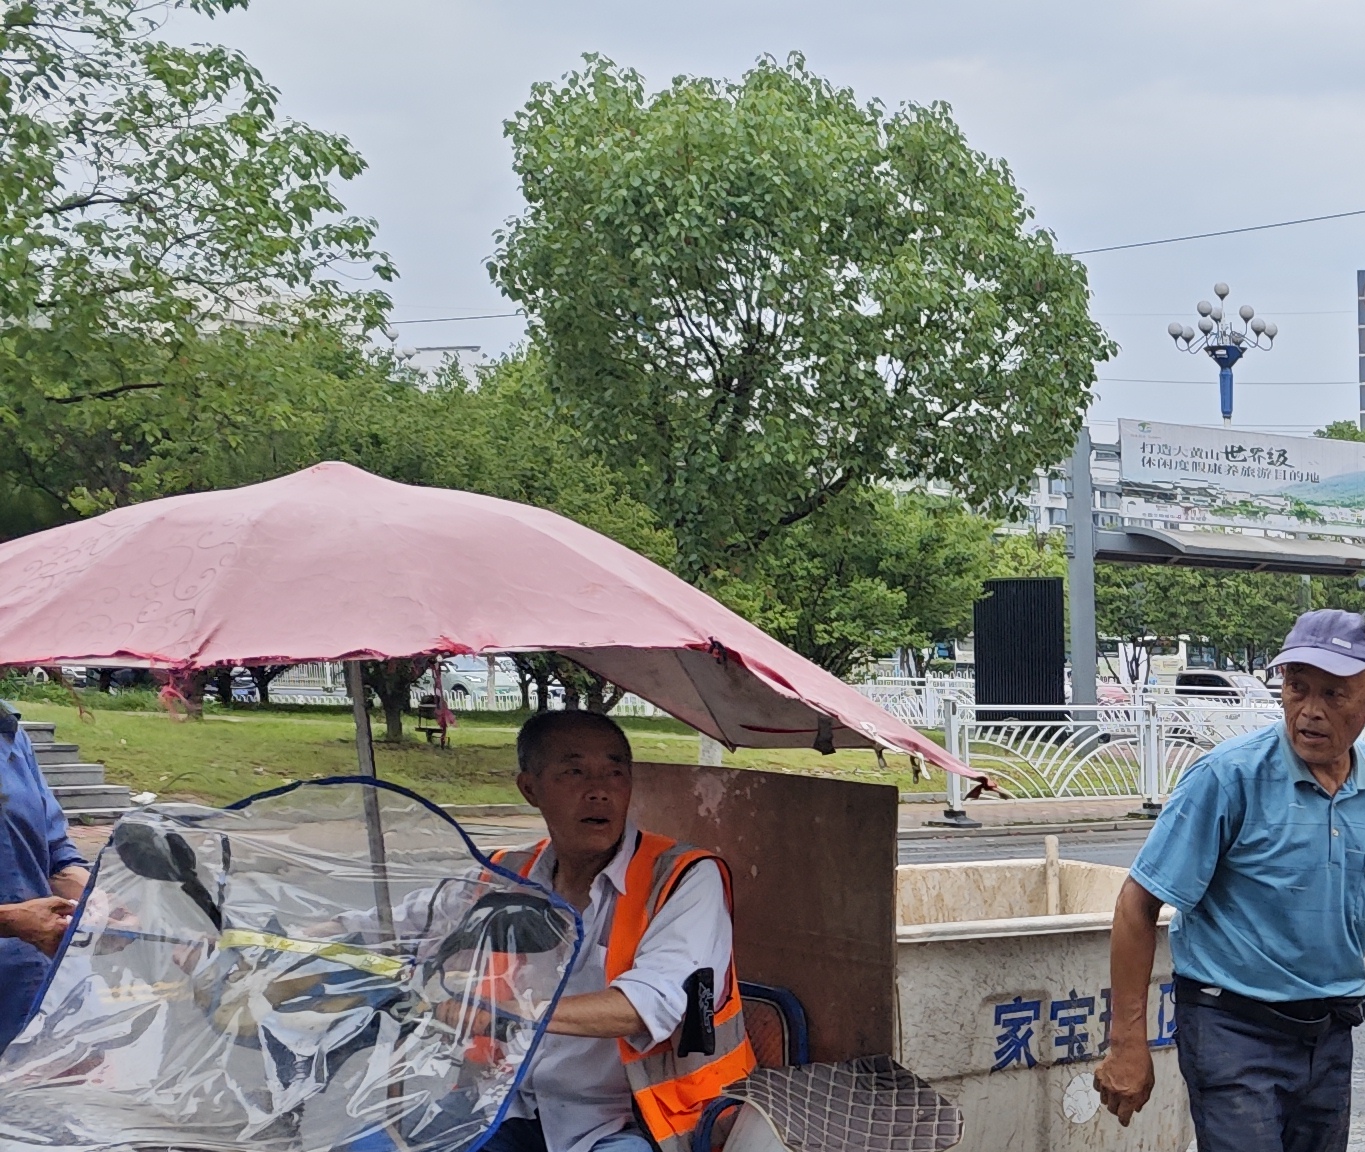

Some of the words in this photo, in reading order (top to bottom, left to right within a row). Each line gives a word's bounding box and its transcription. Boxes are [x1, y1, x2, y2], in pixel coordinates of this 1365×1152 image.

[1140, 441, 1295, 469] 打造大黄山世界级
